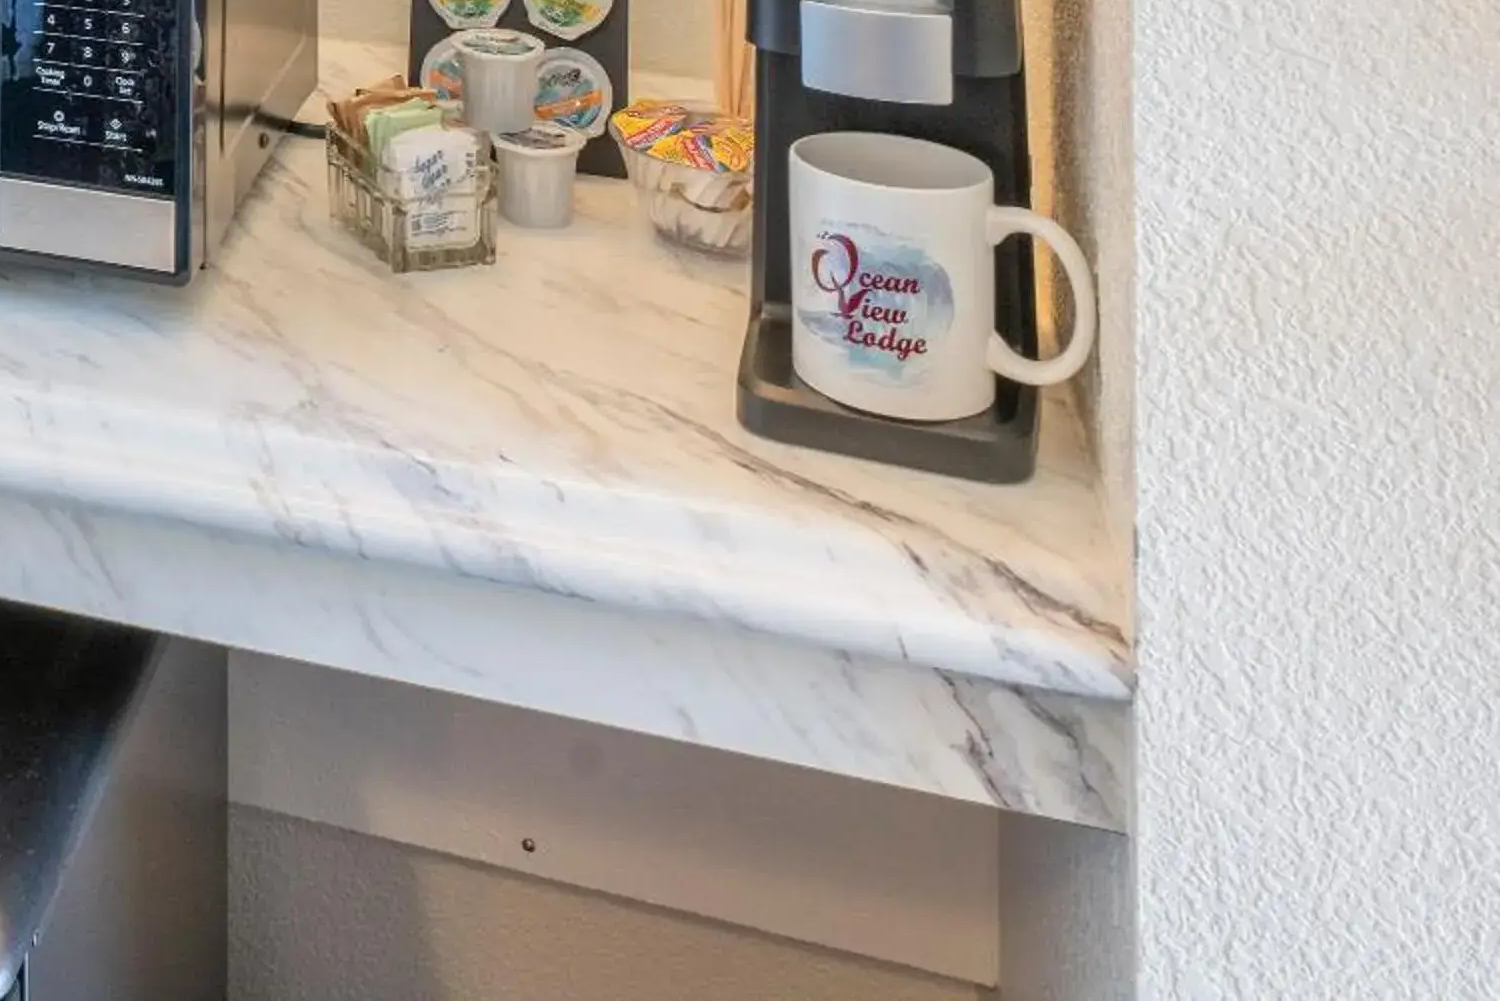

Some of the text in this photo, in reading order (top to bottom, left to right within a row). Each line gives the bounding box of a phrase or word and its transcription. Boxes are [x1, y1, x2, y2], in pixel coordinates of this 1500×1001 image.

[47, 14, 131, 34] 4 5 6
[46, 42, 130, 63] 7 8 9
[83, 75, 93, 87] 0
[105, 130, 127, 142] Start
[811, 232, 922, 295] Ocean
[835, 284, 910, 325] View
[842, 319, 928, 362] Lodge
